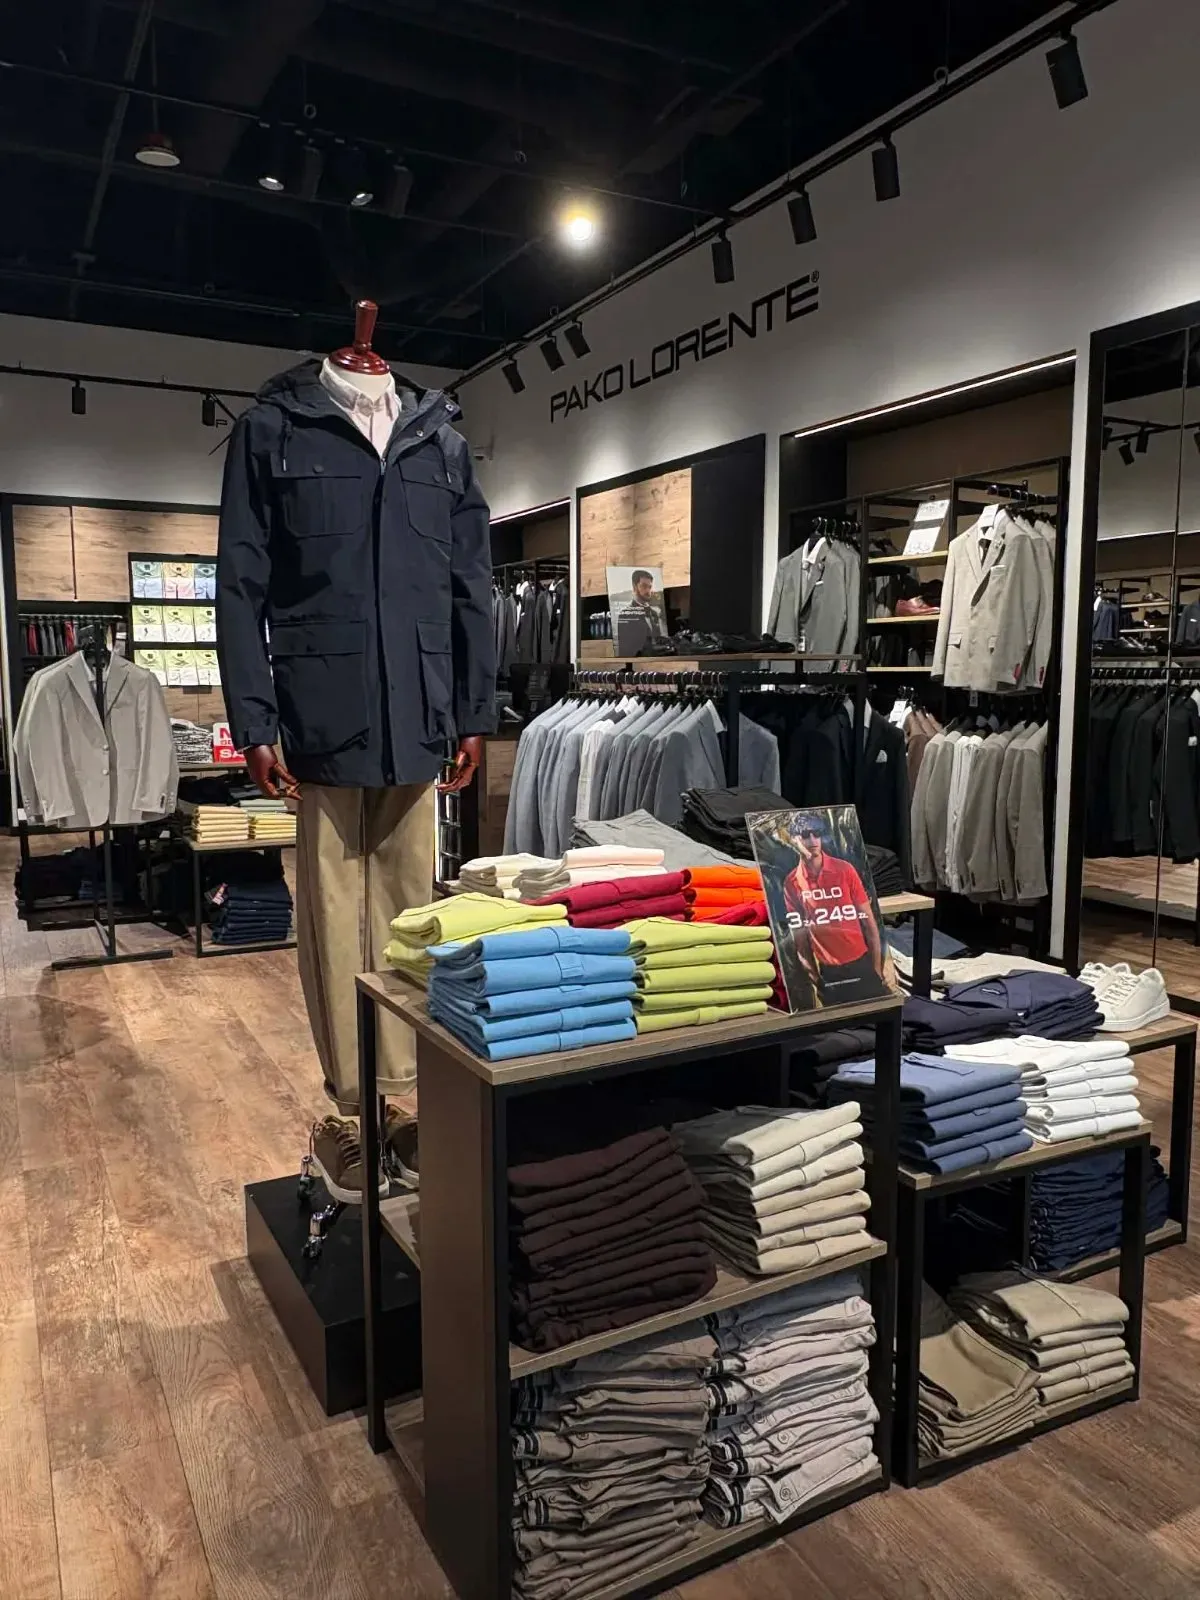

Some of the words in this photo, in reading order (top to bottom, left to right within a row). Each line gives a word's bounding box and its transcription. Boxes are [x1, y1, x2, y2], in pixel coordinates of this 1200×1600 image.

[550, 364, 624, 423] PAKO
[801, 886, 842, 903] POLO
[786, 911, 803, 929] 3
[814, 904, 857, 925] 249
